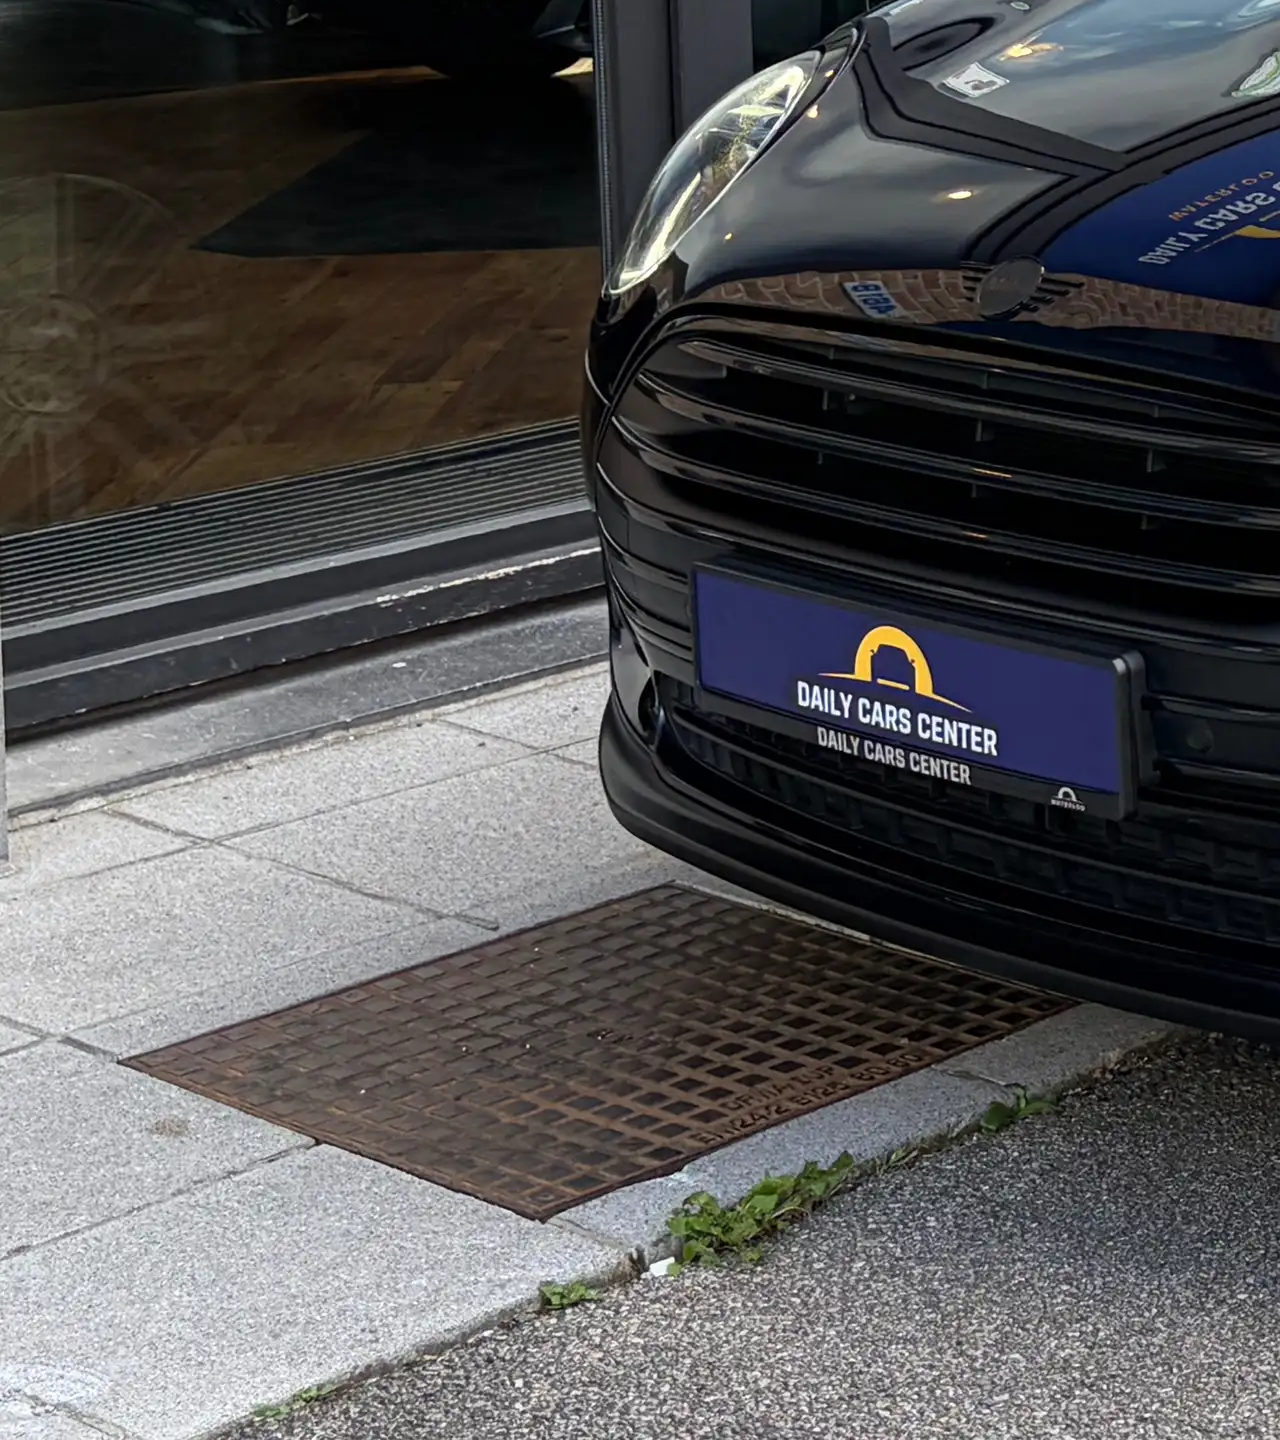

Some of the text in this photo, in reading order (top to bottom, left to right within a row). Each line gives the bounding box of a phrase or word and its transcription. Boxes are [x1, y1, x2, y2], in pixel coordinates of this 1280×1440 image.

[797, 680, 998, 757] DAILY CARS CENTER
[817, 726, 972, 786] DAILY CARS CENTER
